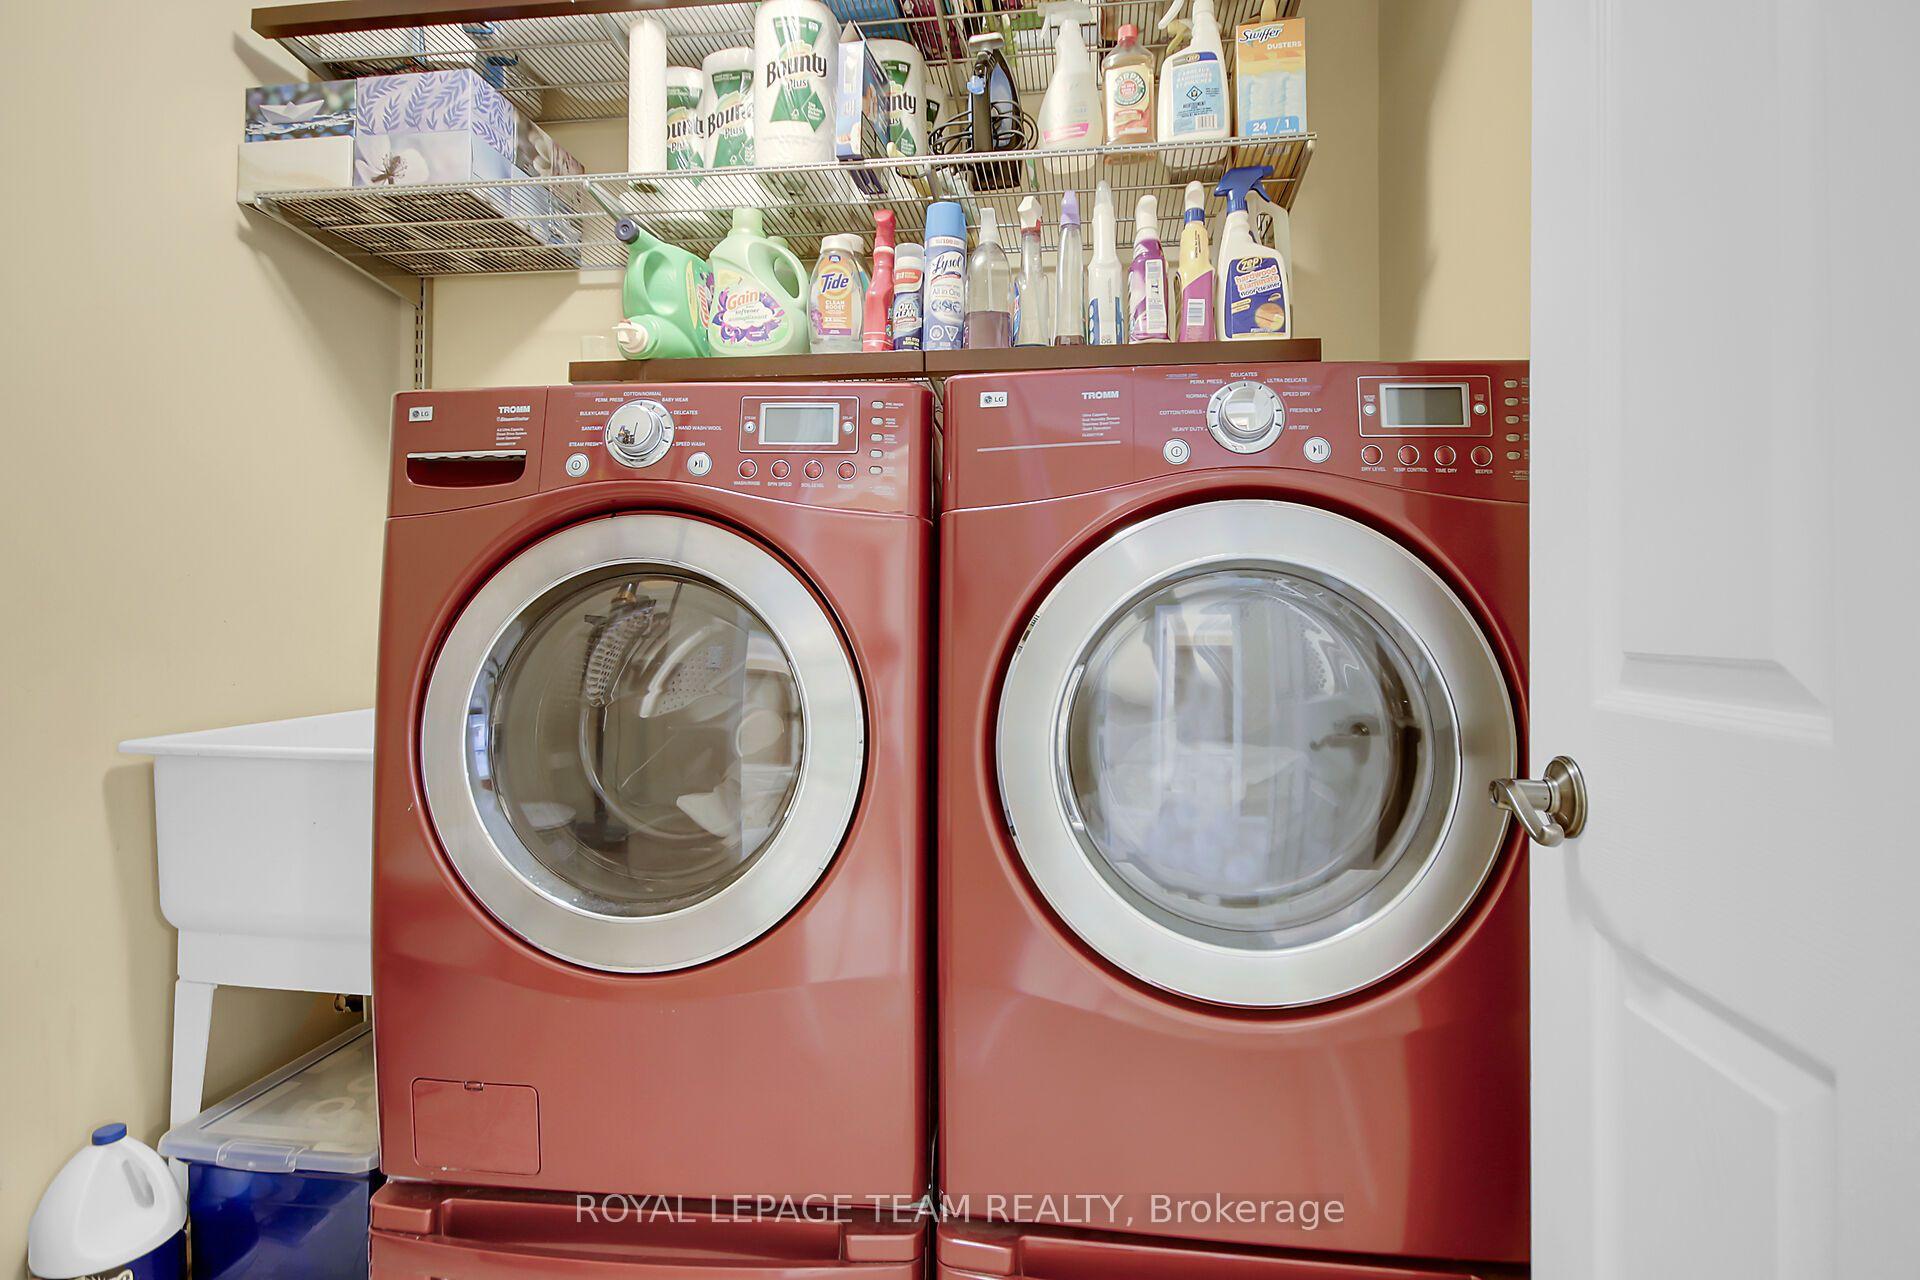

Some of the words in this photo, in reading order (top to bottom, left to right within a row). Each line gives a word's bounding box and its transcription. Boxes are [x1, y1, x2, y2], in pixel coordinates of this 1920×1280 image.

[1240, 26, 1282, 42] Swiffer
[1267, 41, 1302, 50] DUSTERS
[766, 52, 827, 88] Bounty
[1252, 121, 1267, 132] 24
[1285, 119, 1290, 129] 1
[932, 254, 962, 275] Lysol
[1235, 267, 1278, 283] hardwood
[1244, 275, 1279, 289] laminate
[821, 273, 850, 293] Tide
[1240, 288, 1256, 297] floor
[1257, 282, 1280, 293] cleaner
[727, 290, 759, 311] Gain
[1081, 391, 1119, 400] TROMM
[498, 405, 531, 414] TROMM
